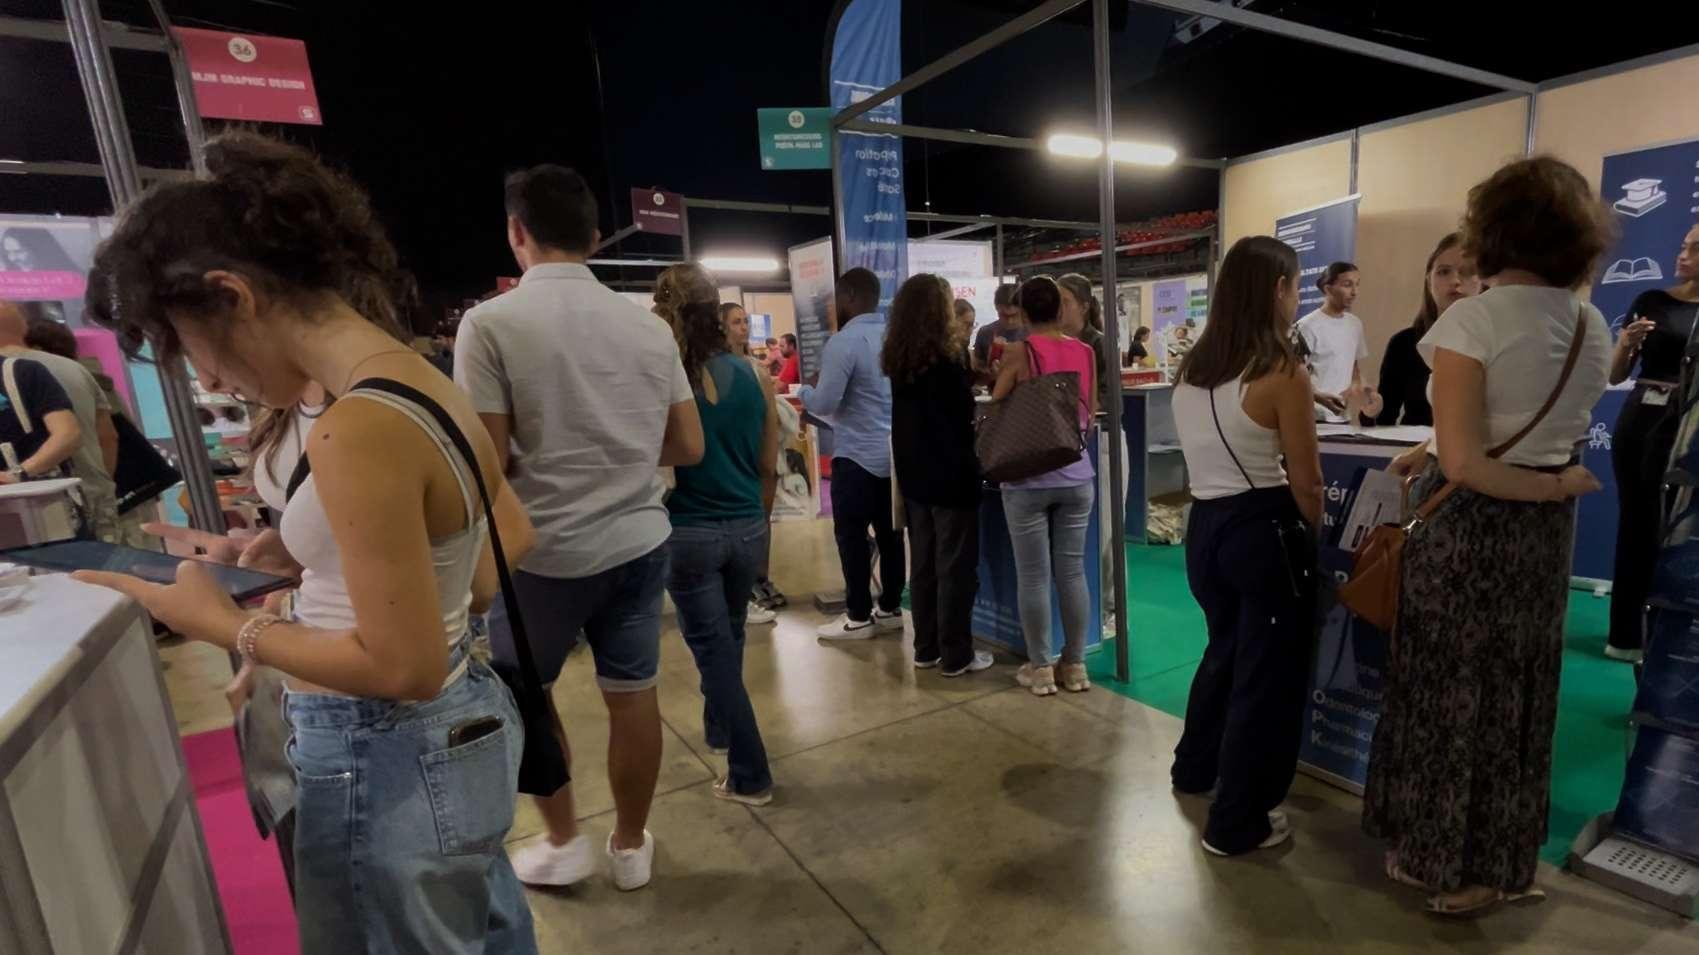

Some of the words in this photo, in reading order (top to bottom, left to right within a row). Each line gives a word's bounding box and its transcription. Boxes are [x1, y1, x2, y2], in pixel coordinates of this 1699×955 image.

[232, 43, 252, 56] 36
[220, 74, 266, 87] GRAPHIC
[268, 78, 305, 90] DESIGN
